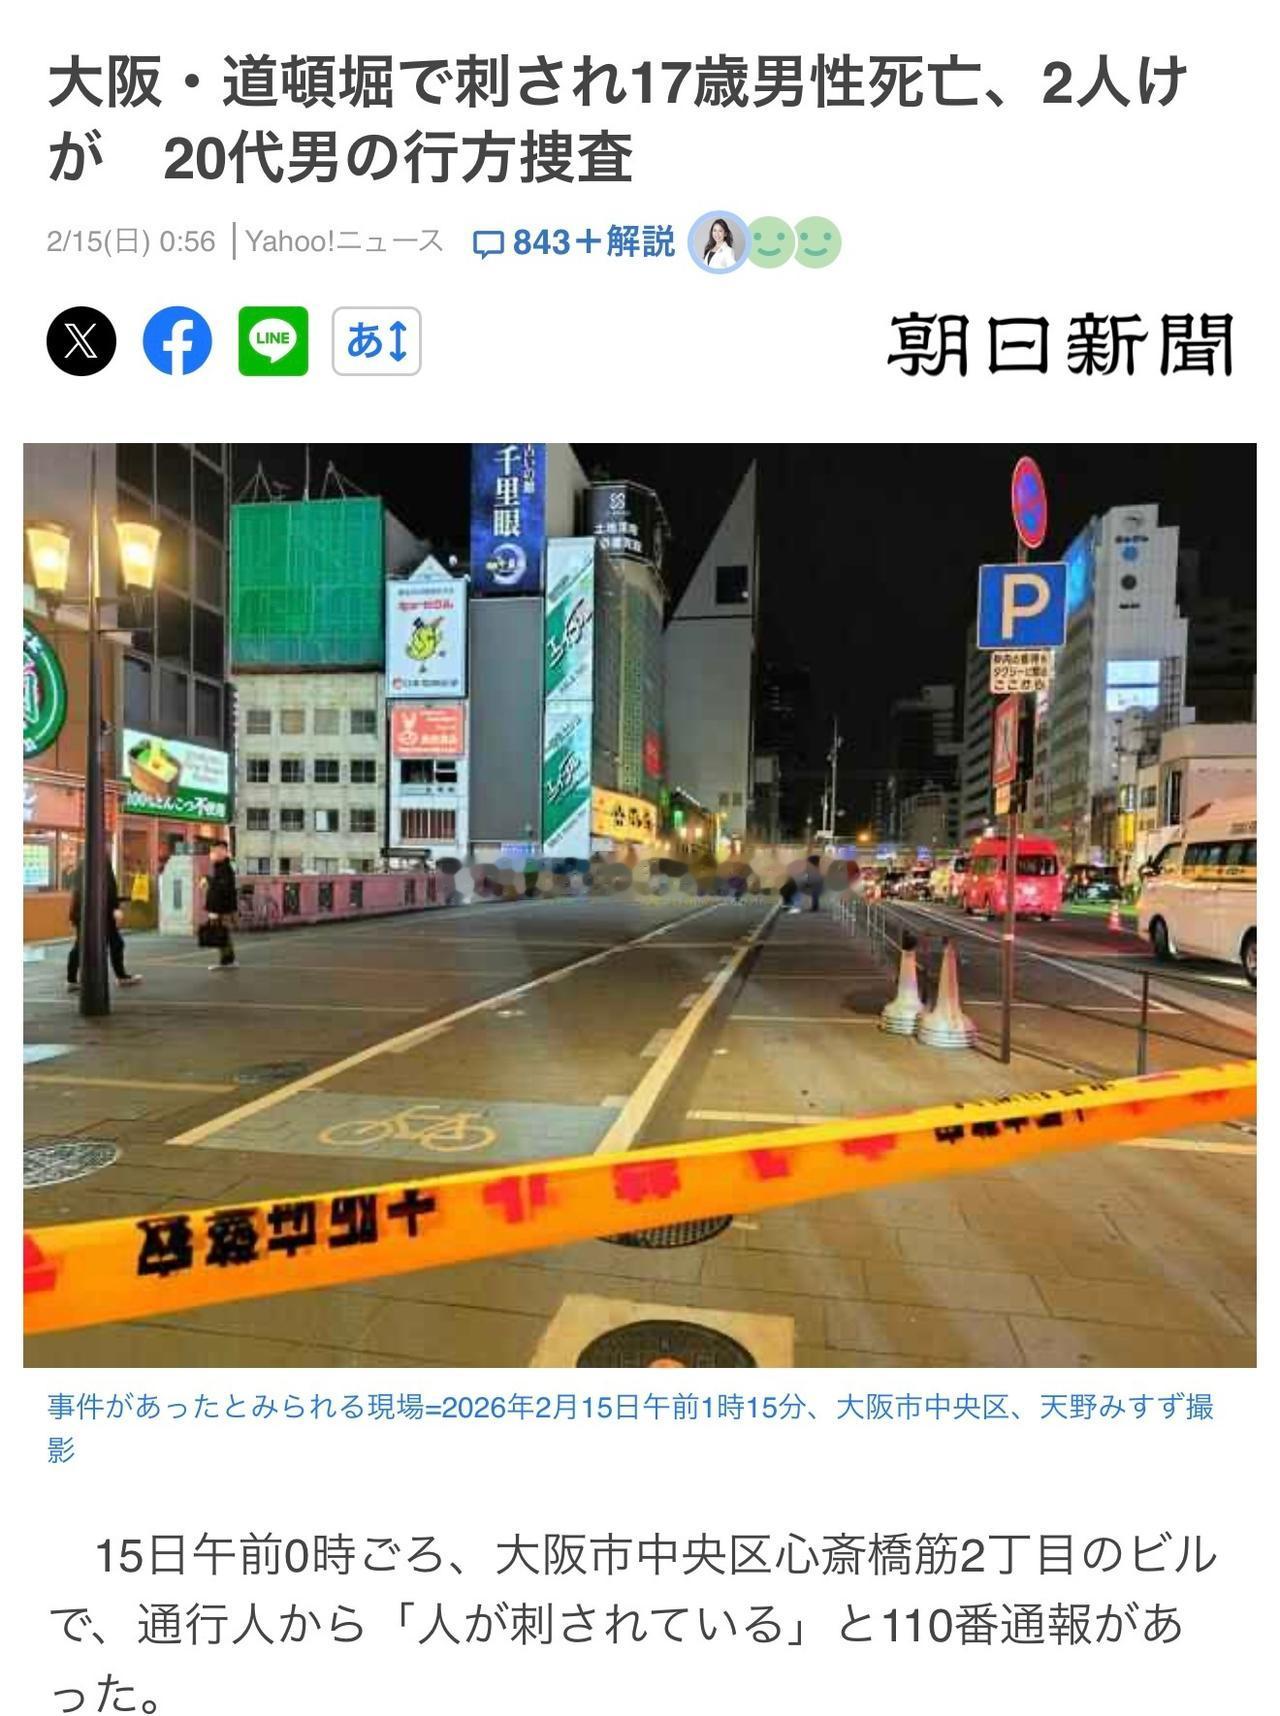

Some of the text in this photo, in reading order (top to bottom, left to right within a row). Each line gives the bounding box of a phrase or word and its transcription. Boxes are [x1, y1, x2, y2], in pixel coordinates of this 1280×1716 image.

[493, 445, 521, 537] 千里眼
[1001, 573, 1051, 640] P
